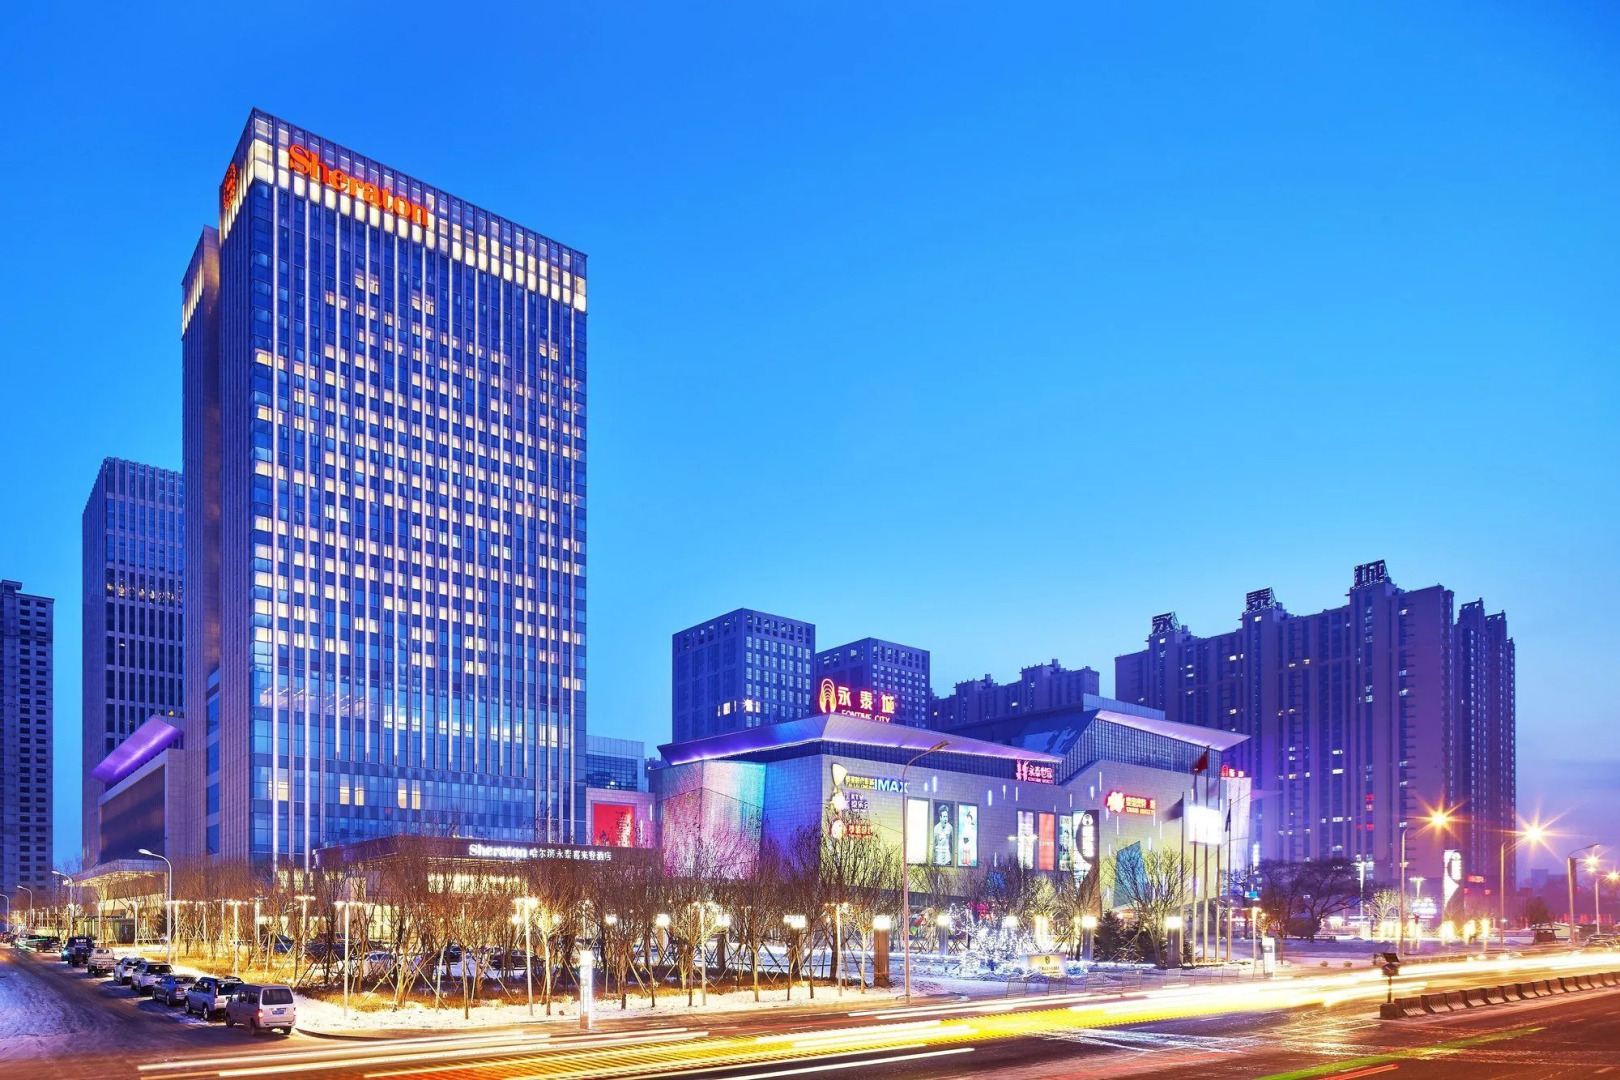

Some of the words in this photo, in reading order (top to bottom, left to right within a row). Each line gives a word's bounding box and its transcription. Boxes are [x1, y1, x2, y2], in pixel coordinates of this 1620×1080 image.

[288, 144, 429, 227] Sheraton
[837, 686, 895, 714] 永泰城
[875, 778, 909, 794] IMAX
[468, 844, 528, 859] Sheraton
